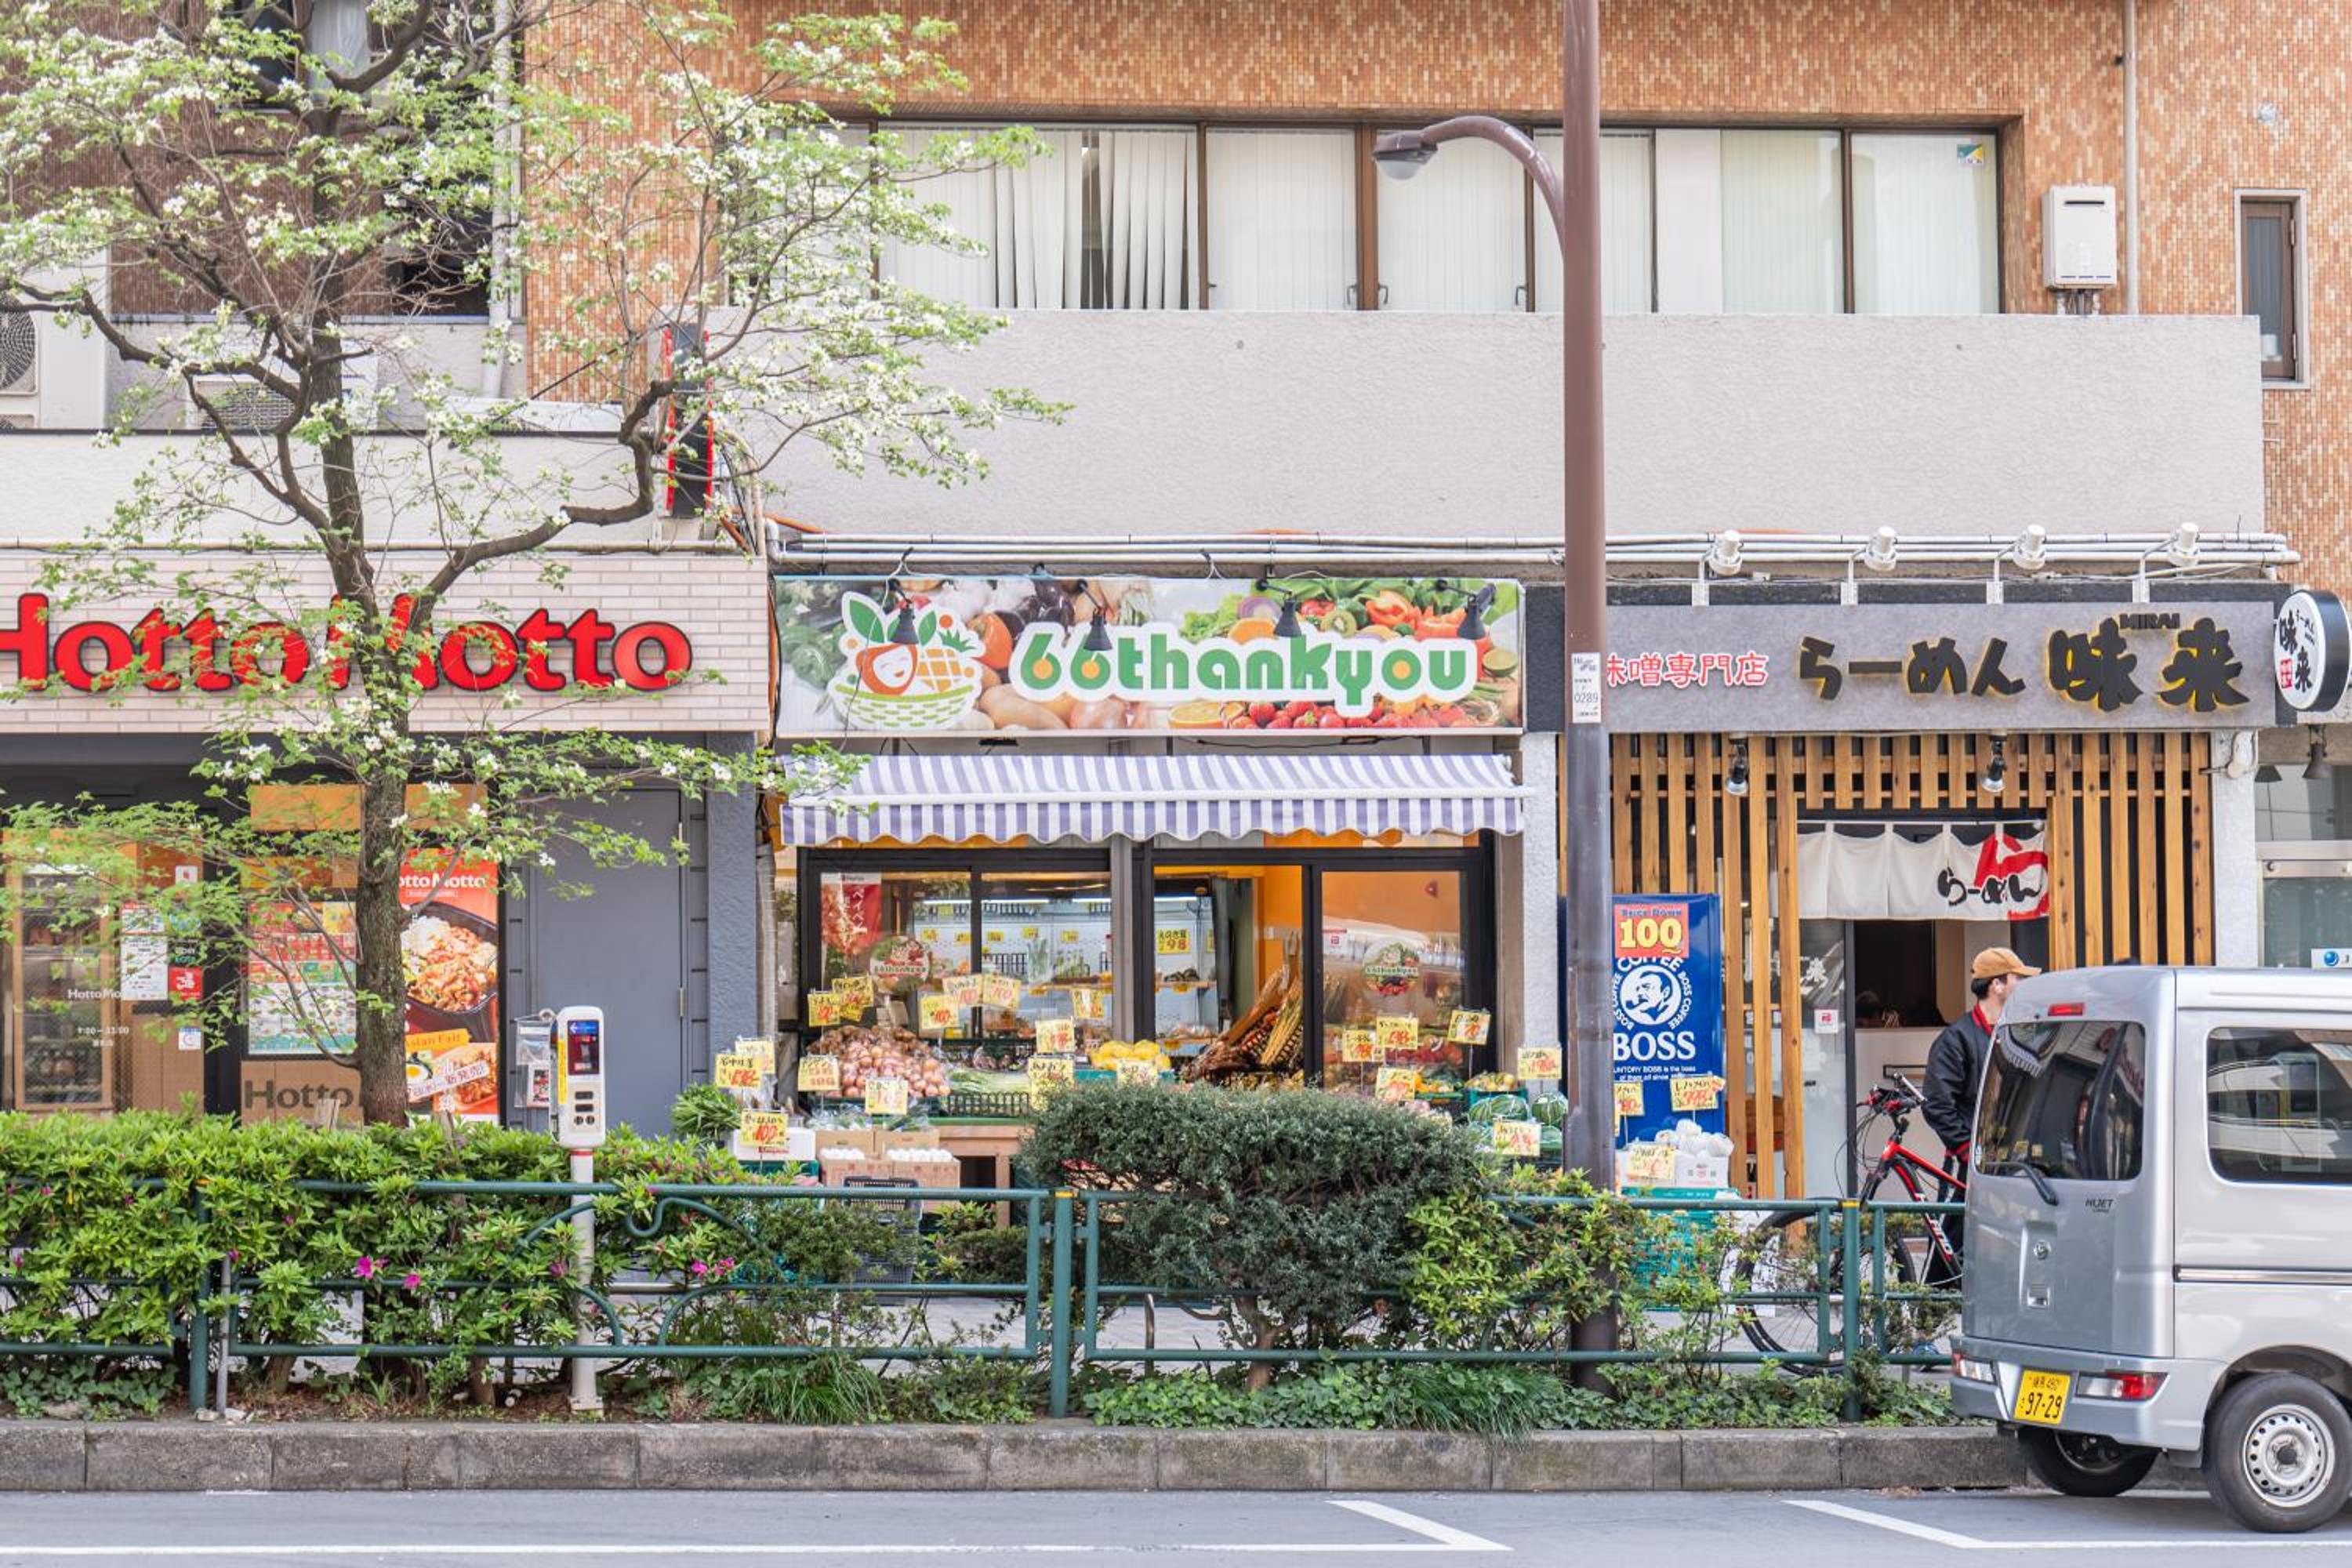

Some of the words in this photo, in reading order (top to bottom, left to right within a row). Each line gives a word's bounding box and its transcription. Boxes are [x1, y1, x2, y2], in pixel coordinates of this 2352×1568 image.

[1020, 633, 1467, 706] 66thankyou
[1799, 636, 2027, 701] らーめん
[2049, 617, 2250, 713] 味来
[1937, 866, 2043, 906] らーめん
[1619, 918, 1682, 949] 100
[1613, 1031, 1696, 1061] BOSS
[244, 1080, 353, 1108] Hotto
